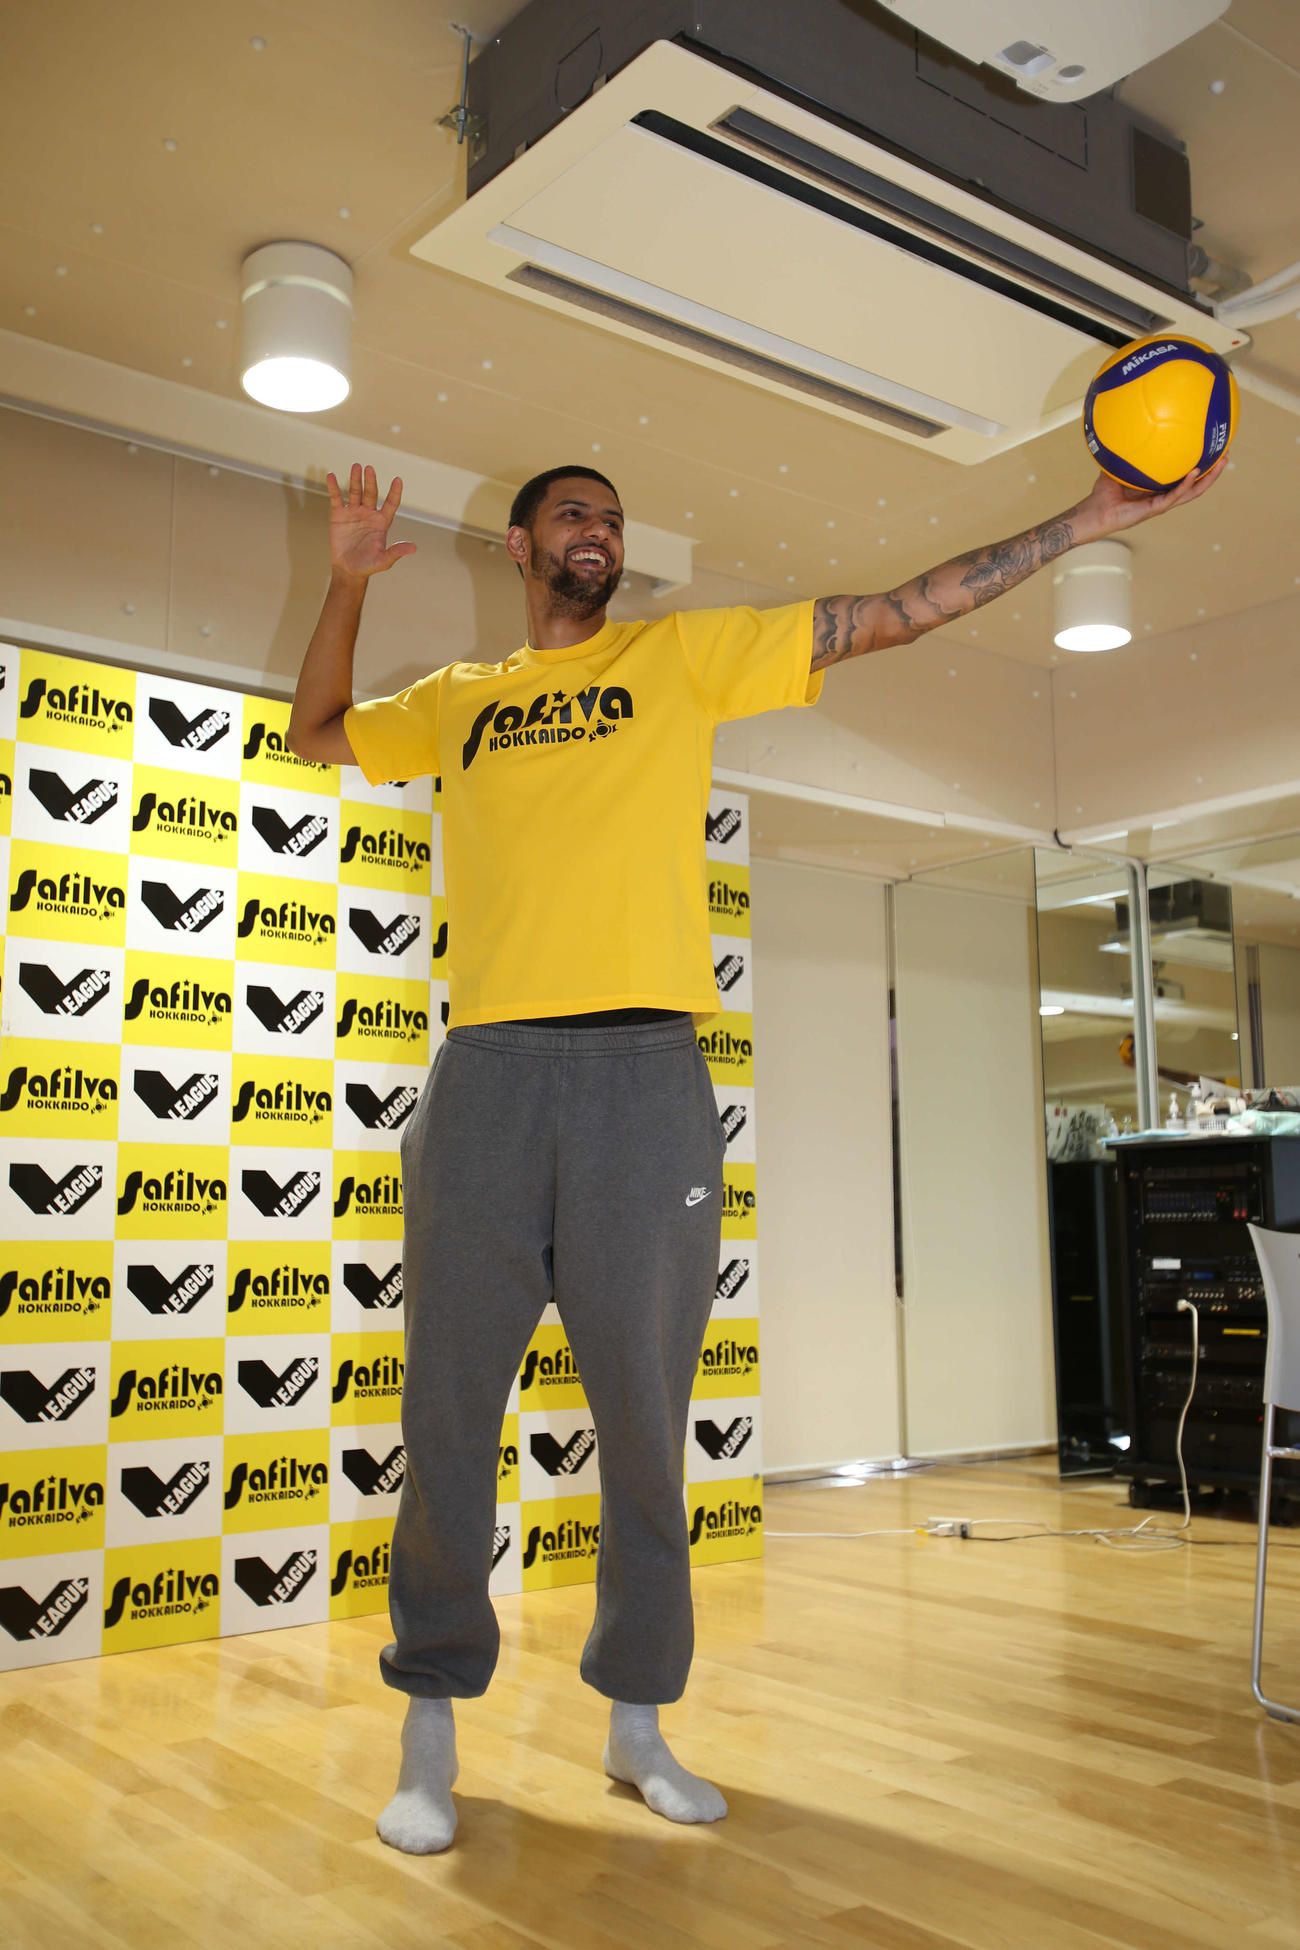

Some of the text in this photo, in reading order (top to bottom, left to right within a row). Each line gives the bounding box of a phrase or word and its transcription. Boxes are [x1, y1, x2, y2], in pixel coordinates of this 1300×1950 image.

[20, 678, 133, 722] Safilva
[46, 710, 105, 729] HOKKAIDO
[181, 710, 230, 750] LEAGUE
[490, 727, 585, 751] HOKKAIDO
[65, 781, 117, 824] LEAGUE
[133, 793, 237, 832] Safilva
[156, 824, 212, 840] HOKKAIDO
[283, 816, 328, 856] LEAGUE
[340, 826, 430, 863] Safilva
[361, 855, 409, 869] HOKKAIDO
[10, 870, 125, 912] Safilva
[37, 902, 97, 917] HOKKAIDO
[174, 889, 223, 932] LEAGUE
[709, 880, 750, 908] filva
[238, 899, 335, 937] Safilva
[260, 929, 312, 942] HOKKAIDO
[378, 915, 420, 956] LEAGUE
[716, 956, 743, 990] EAGUE
[56, 971, 110, 1016] LEAGUE
[125, 979, 231, 1020] Safilva
[278, 992, 323, 1034] LEAGUE
[150, 1010, 205, 1023] HOKKAIDO
[337, 999, 428, 1037] Safilva
[358, 1028, 406, 1039] HOKKAIDO
[699, 1031, 751, 1055] afilva
[0, 1065, 117, 1112] Safilva
[27, 1100, 89, 1112] HOKKAIDO
[169, 1074, 218, 1120] LEAGUE
[232, 1081, 332, 1122] Safilva
[375, 1087, 418, 1129] LEAGUE
[255, 1111, 308, 1122] HOKKAIDO
[47, 1166, 103, 1215] LEAGUE
[117, 1169, 226, 1215] Safilva
[143, 1201, 200, 1212] HOKKAIDO
[274, 1172, 320, 1217] LEAGUE
[334, 1174, 403, 1217] Safil
[690, 1187, 707, 1198] NIKE
[0, 1267, 110, 1317] Safilva
[18, 1302, 81, 1314] HOKKAIDO
[163, 1265, 213, 1314] LEAGUE
[228, 1265, 329, 1312] Safilva
[251, 1296, 305, 1308] HOKKAIDO
[699, 1340, 758, 1366] afilva
[703, 1367, 741, 1376] HOKKAIDO
[38, 1367, 95, 1423] LEAGUE
[111, 1365, 222, 1417] Safilva
[271, 1358, 319, 1408] LEAGUE
[137, 1399, 195, 1411] HOKKAIDO
[557, 1429, 595, 1475] LEAGUE
[718, 1417, 752, 1460] LEAGUE
[158, 1462, 210, 1517] LEAGUE
[225, 1457, 328, 1509] Safilva
[249, 1489, 303, 1503] HOKKAIDO
[9, 1512, 74, 1527] HOKKAIDO
[690, 1502, 761, 1546] Safilva
[707, 1527, 745, 1540] HOKKAIDO
[331, 1542, 389, 1597] Safi
[543, 1549, 587, 1562] HOKKAIDO
[268, 1551, 316, 1605] LEAGUE
[30, 1578, 88, 1639] LEAGUE
[104, 1569, 218, 1628] Safilva
[131, 1602, 191, 1619] HOKKAIDO
